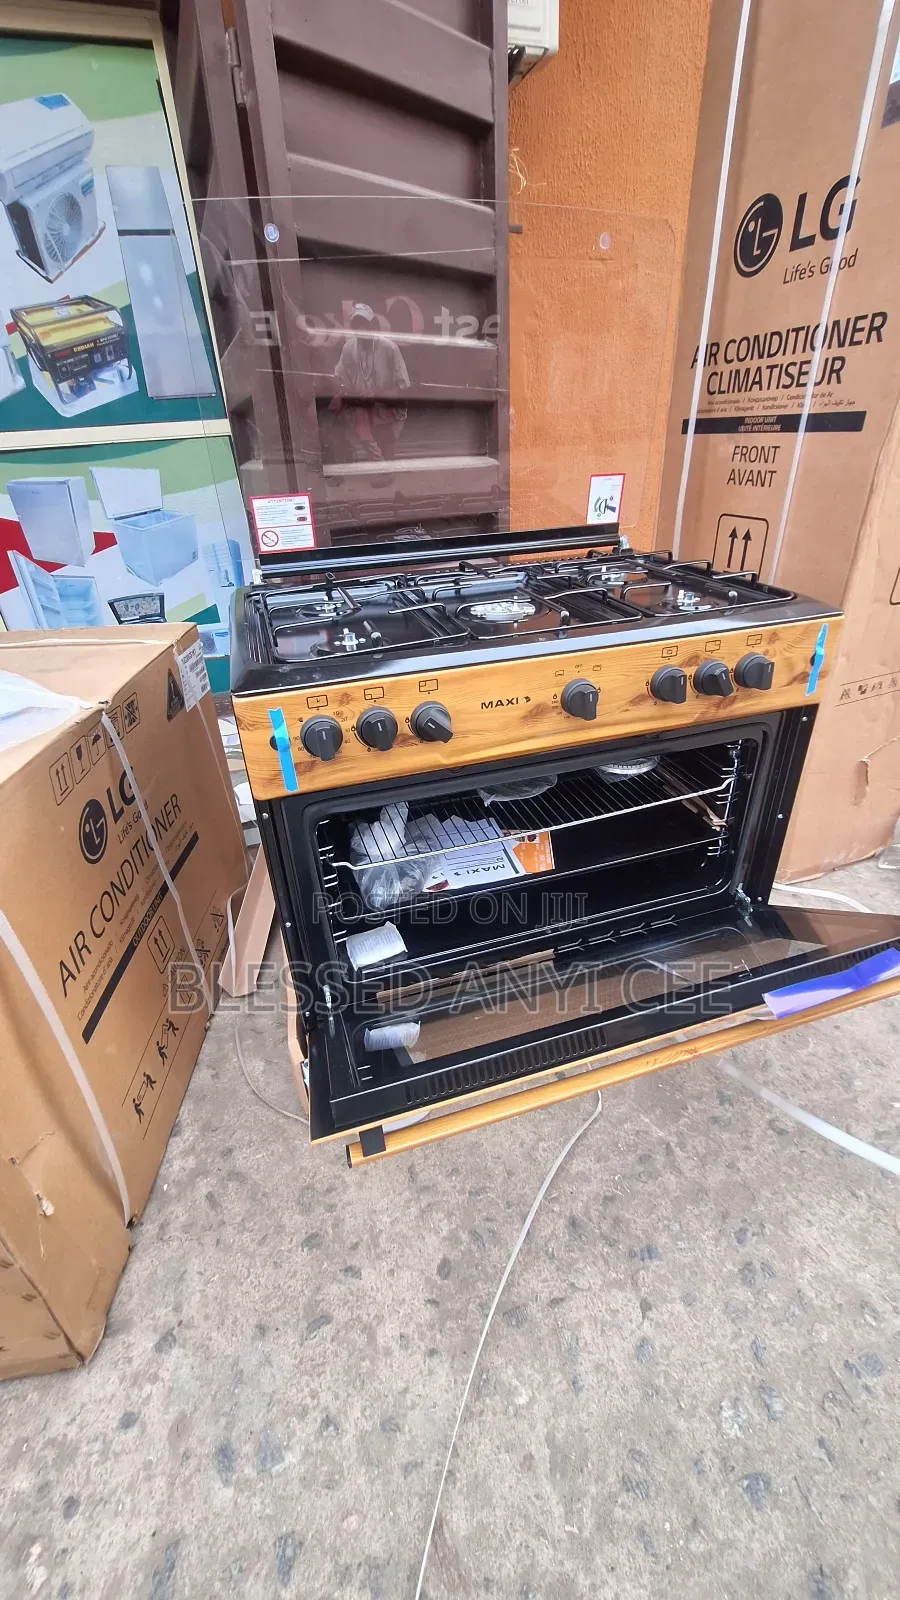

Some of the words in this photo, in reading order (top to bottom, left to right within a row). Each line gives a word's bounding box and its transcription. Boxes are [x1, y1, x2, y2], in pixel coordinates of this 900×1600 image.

[789, 174, 861, 252] LG
[783, 261, 816, 285] Life's
[723, 311, 888, 365] CONDITIONER
[706, 355, 846, 396] CLIMATISEUR
[731, 445, 781, 464] FRONT
[726, 468, 778, 488] AVANT
[480, 697, 519, 710] MAXI
[117, 820, 133, 845] Life's
[132, 799, 149, 823] God
[466, 863, 506, 875] MAXI
[59, 929, 93, 998] AIR
[90, 792, 182, 939] CONDITIONER
[132, 908, 154, 947] OUTDOOR
